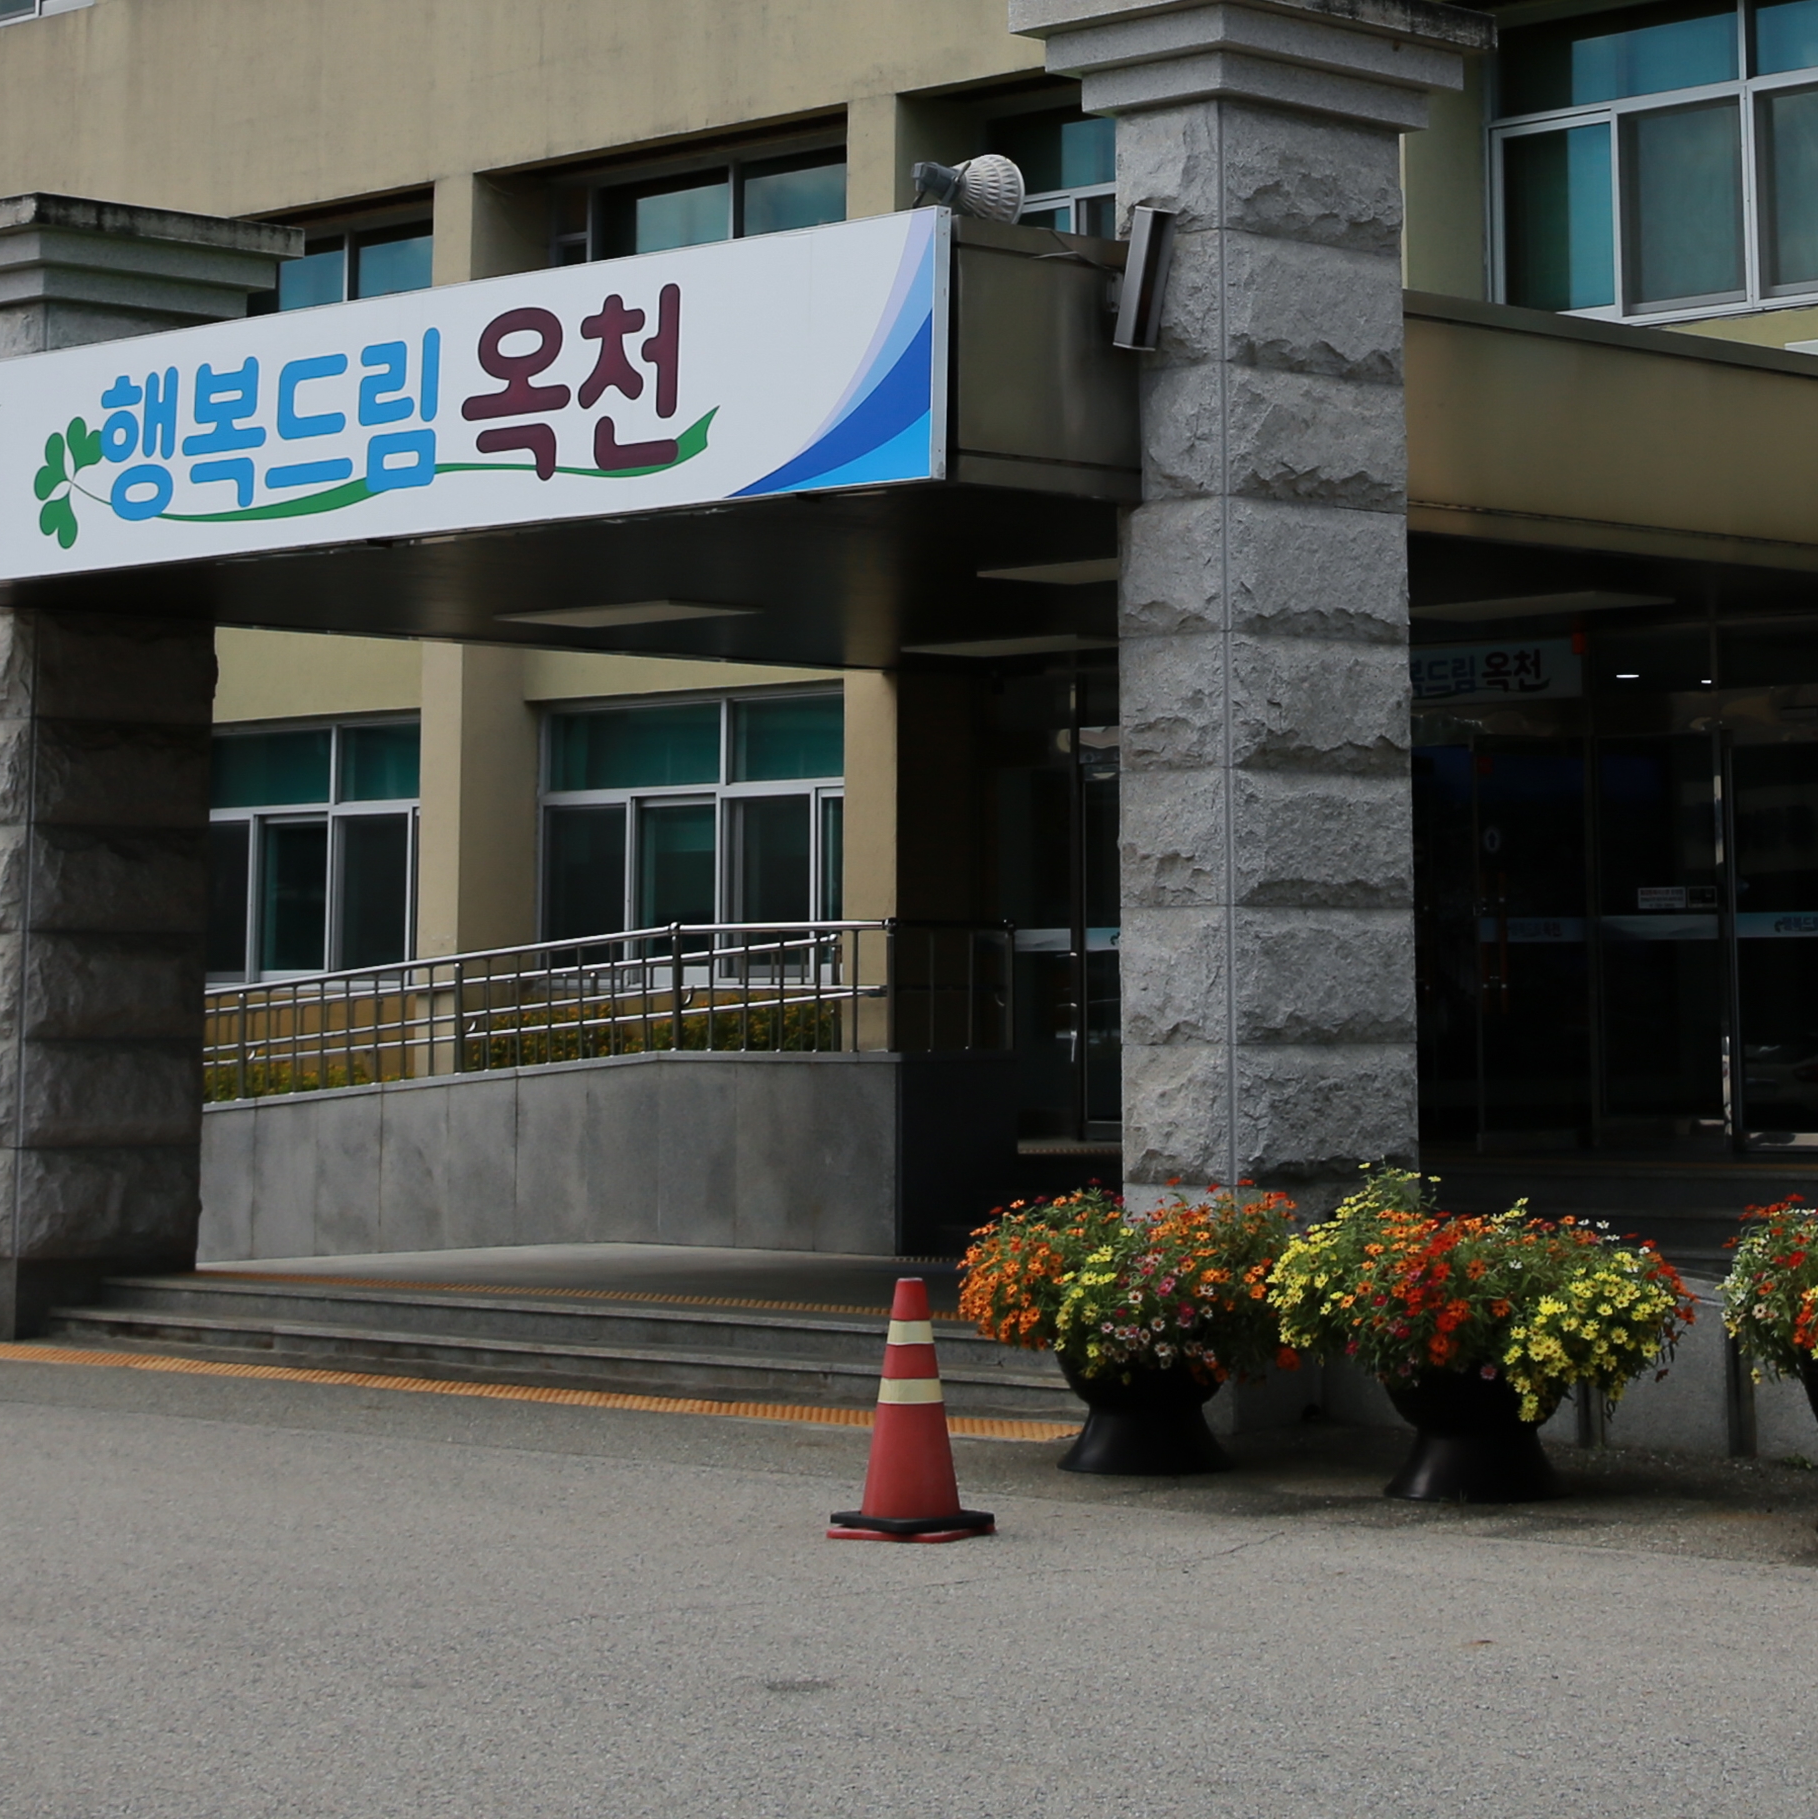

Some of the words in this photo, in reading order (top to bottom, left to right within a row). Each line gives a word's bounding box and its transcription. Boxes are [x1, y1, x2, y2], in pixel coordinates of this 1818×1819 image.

[100, 327, 441, 521] 행복드림
[460, 282, 681, 481] 옥천
[1481, 648, 1544, 692] 옥천
